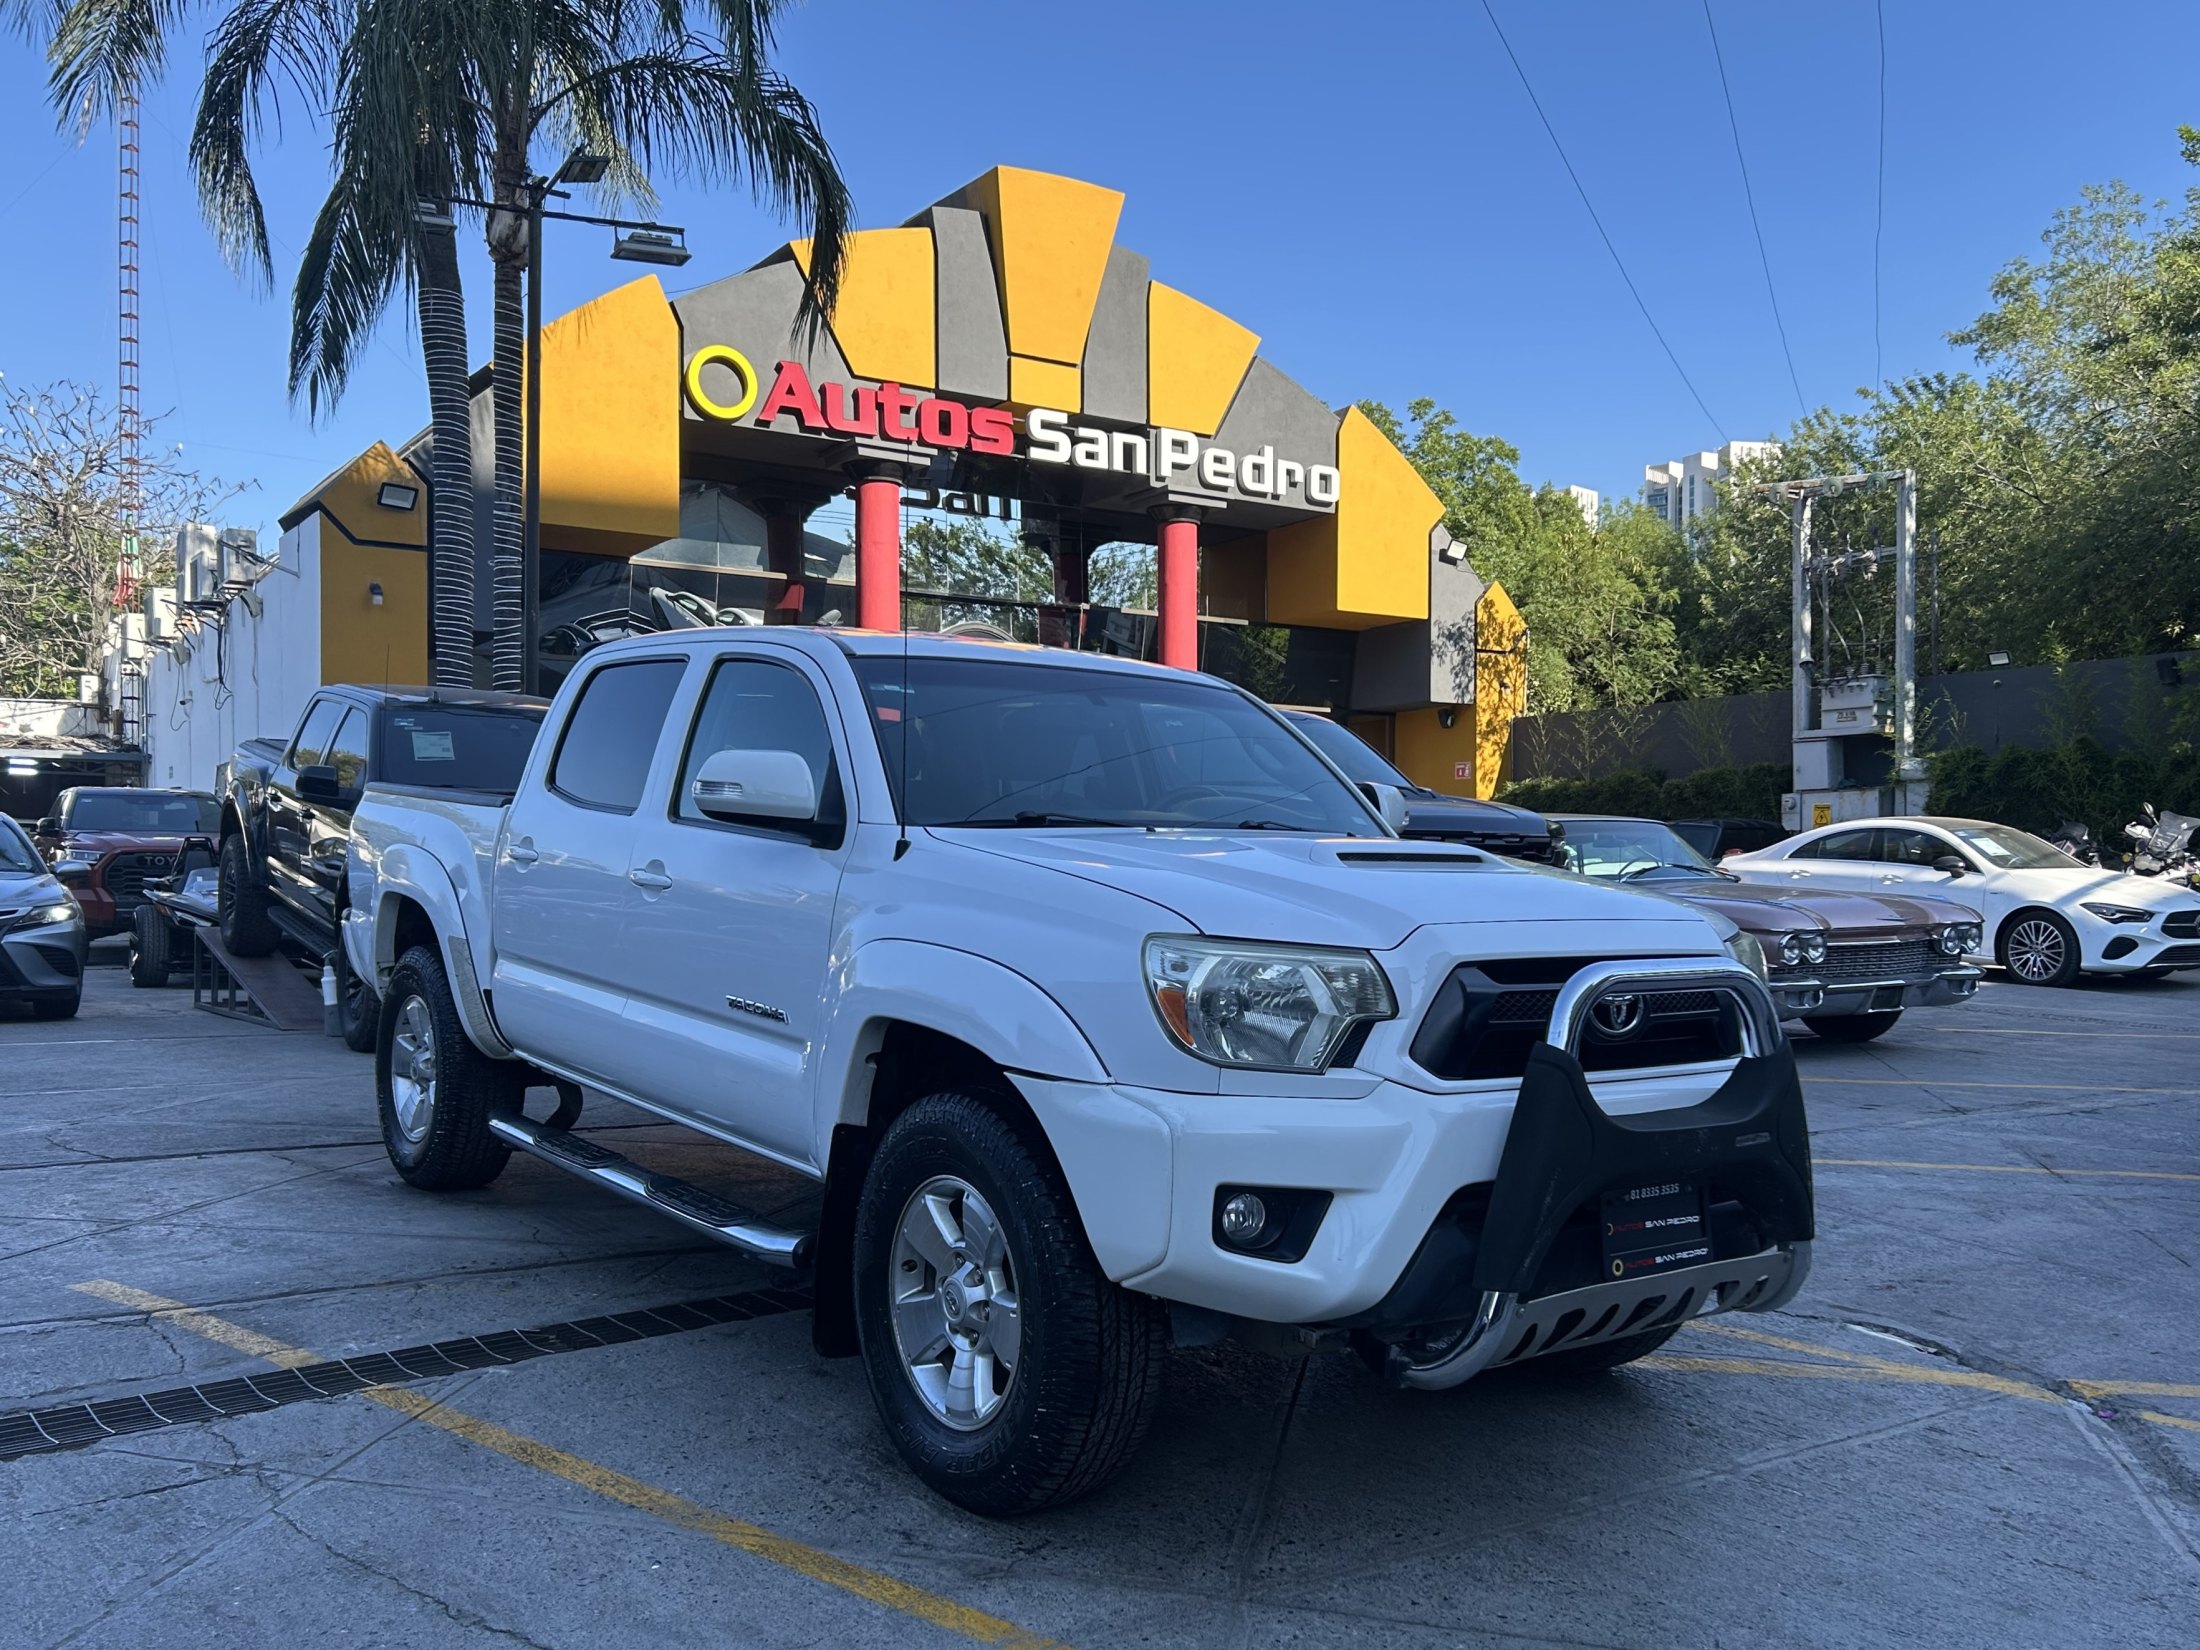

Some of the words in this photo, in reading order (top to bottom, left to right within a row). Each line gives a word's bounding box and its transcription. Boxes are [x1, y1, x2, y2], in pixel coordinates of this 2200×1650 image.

[759, 360, 1014, 455] Autos
[143, 856, 178, 866] TOY
[725, 994, 791, 1025] TACOMA
[1630, 1189, 1640, 1200] 81
[1640, 1186, 1660, 1198] 8335
[1660, 1183, 1679, 1195] 3535
[1645, 1219, 1666, 1228] SAN
[1666, 1215, 1700, 1226] PEDRO
[1655, 1254, 1675, 1263] SAN
[1676, 1248, 1708, 1259] PEDRO
